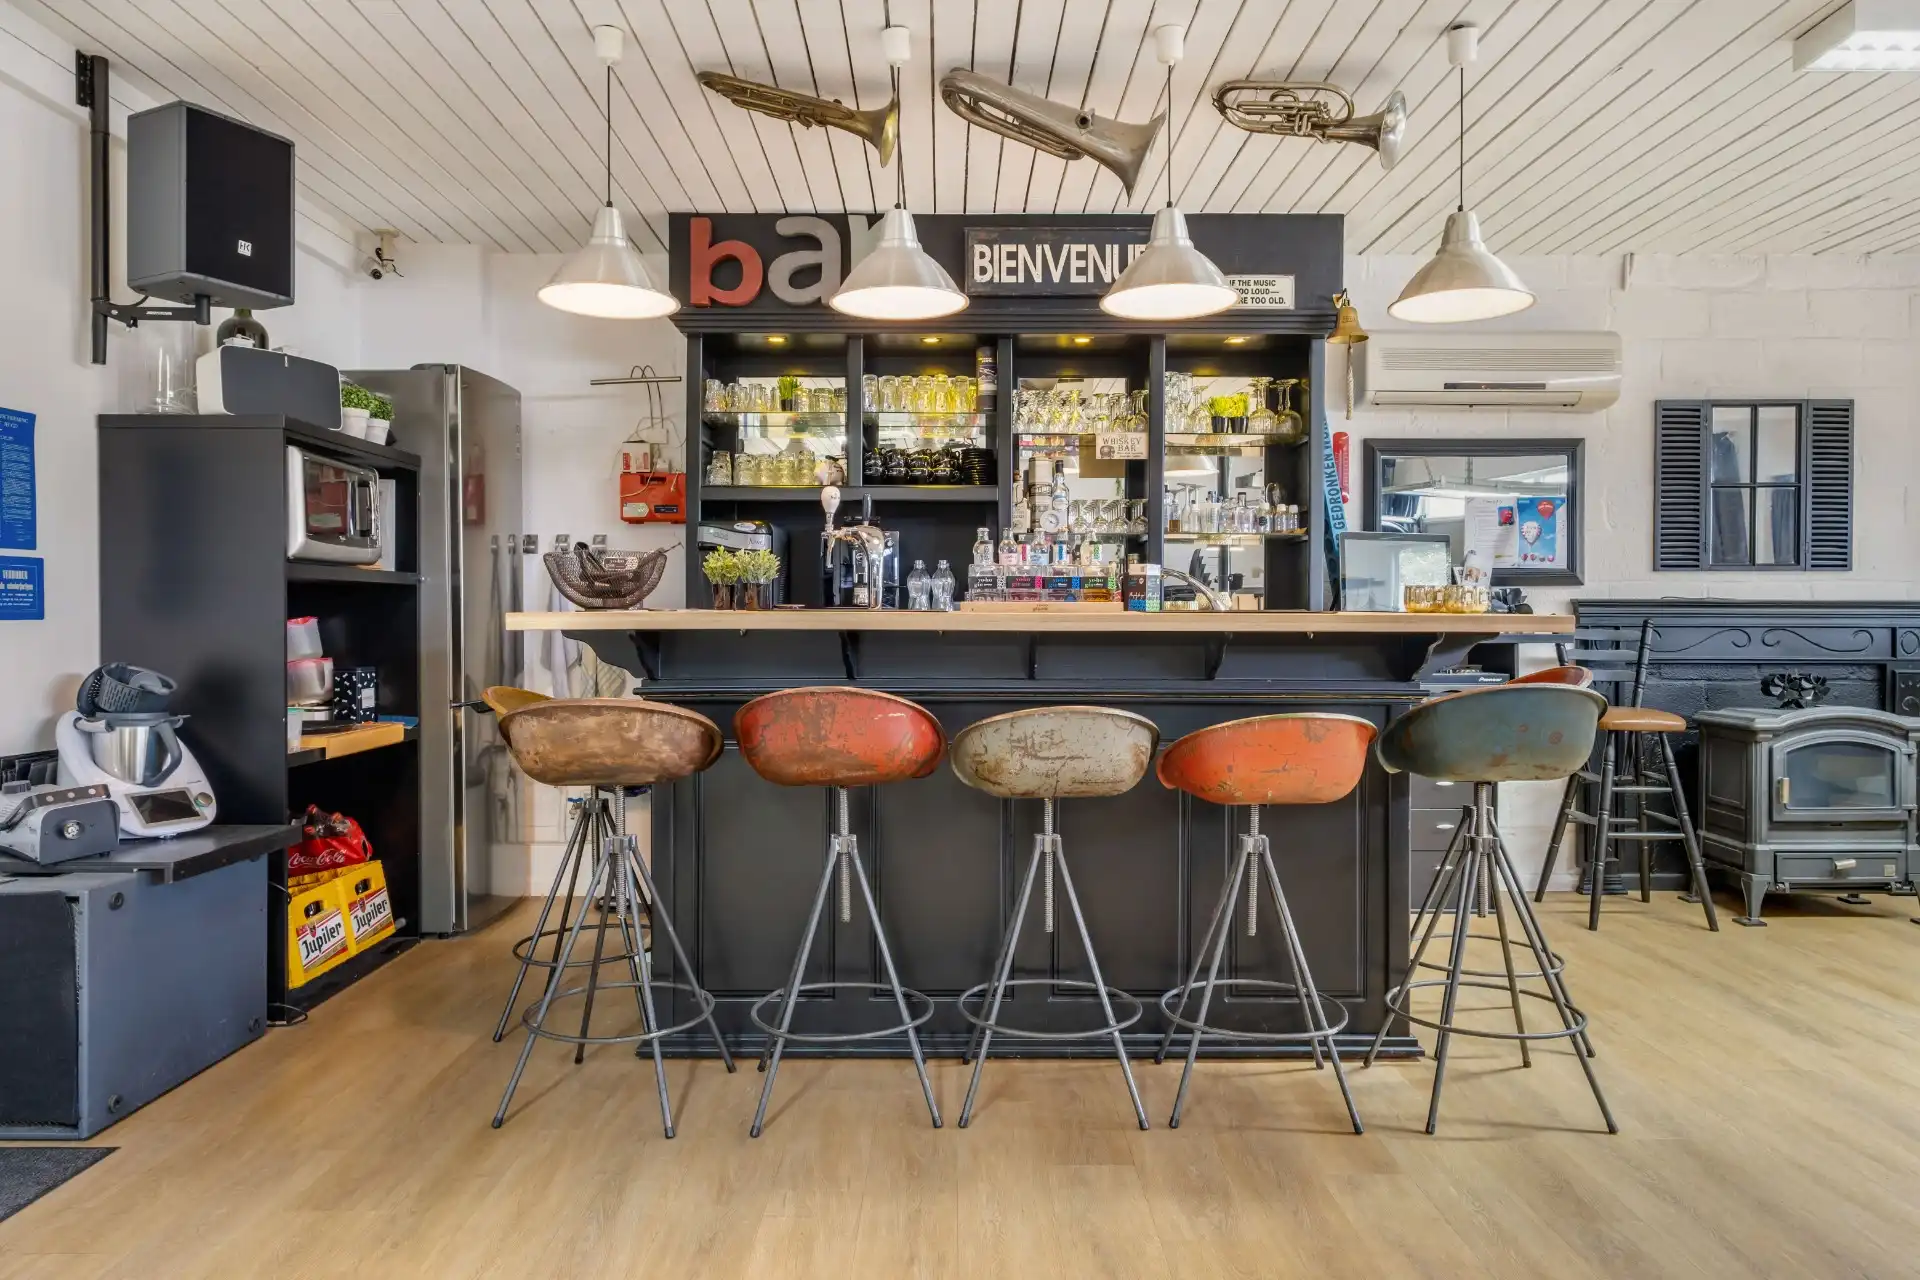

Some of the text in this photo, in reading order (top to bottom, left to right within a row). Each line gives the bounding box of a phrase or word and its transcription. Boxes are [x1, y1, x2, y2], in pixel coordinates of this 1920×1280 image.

[1238, 279, 1252, 287] THE
[1253, 279, 1276, 287] MUSIC
[1102, 437, 1142, 445] WHISKEY
[1117, 444, 1137, 452] BAR
[1324, 453, 1346, 530] GEDRONKEN
[354, 898, 388, 932] Jupiler
[302, 921, 342, 960] Jupiler
